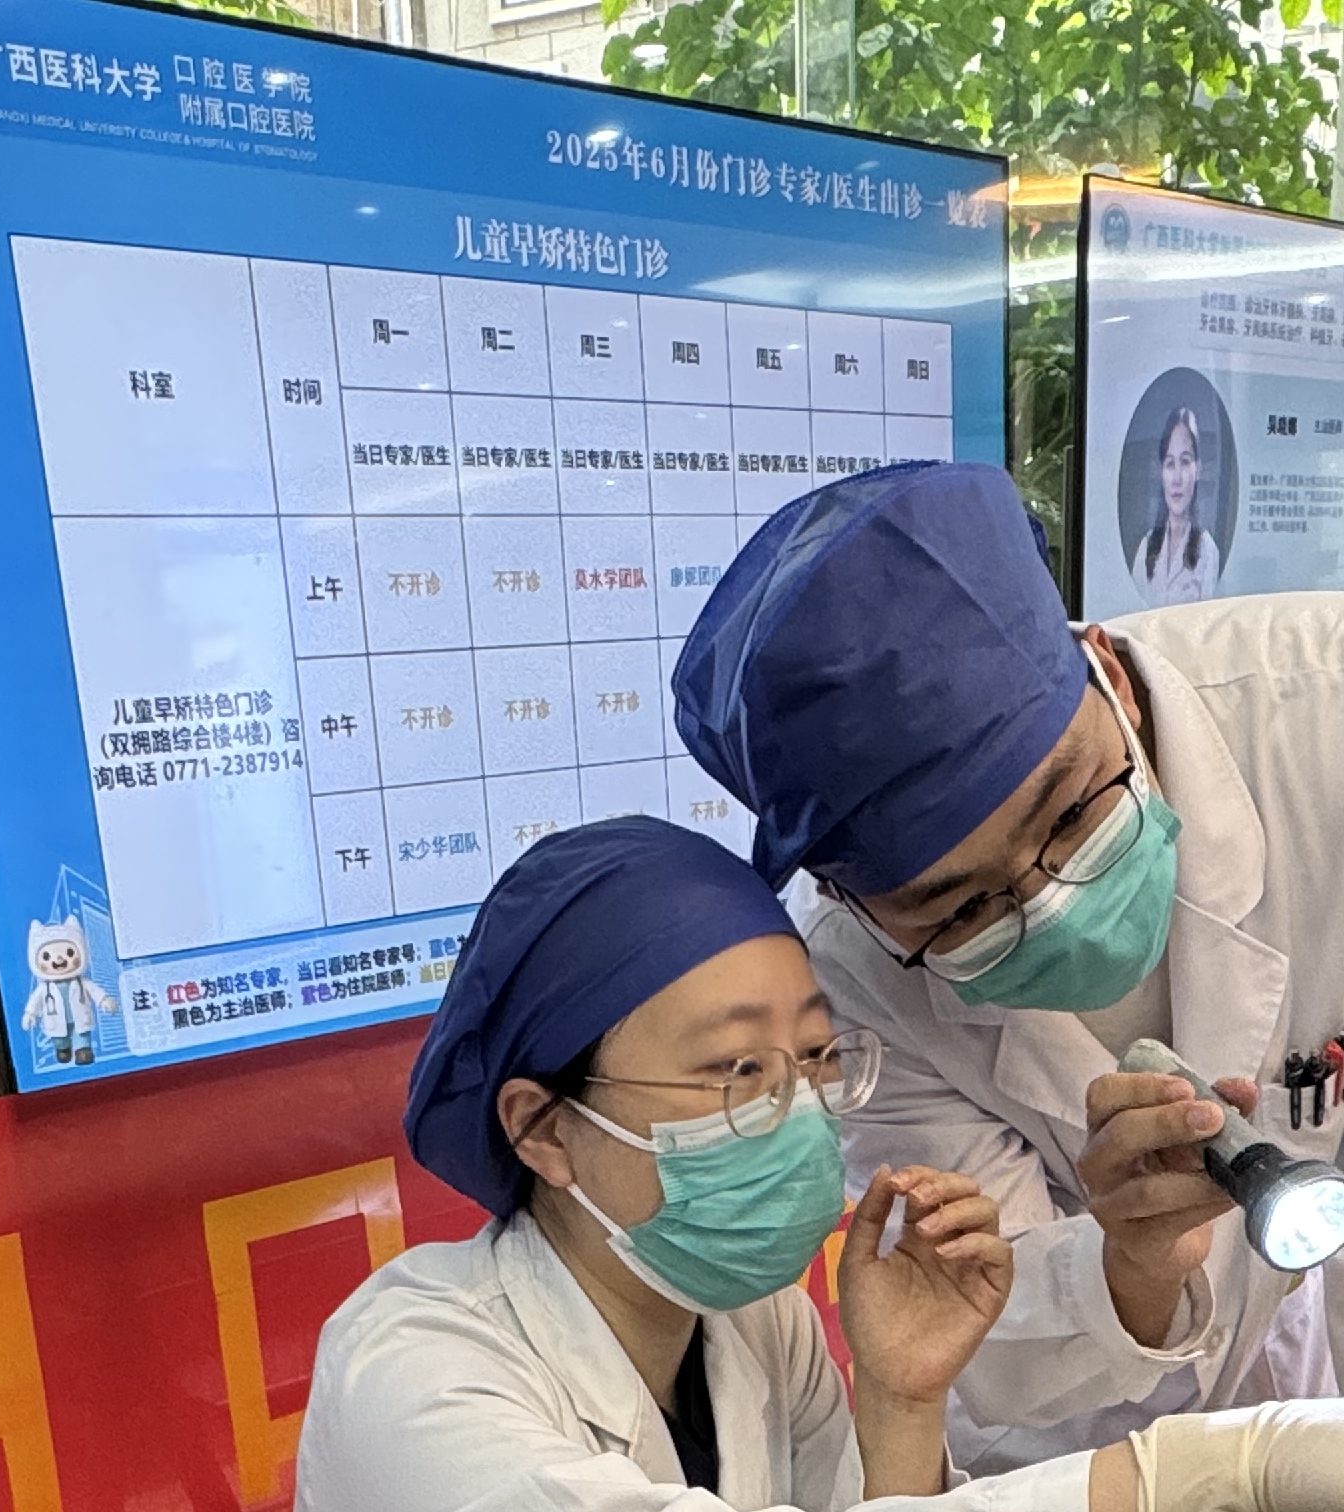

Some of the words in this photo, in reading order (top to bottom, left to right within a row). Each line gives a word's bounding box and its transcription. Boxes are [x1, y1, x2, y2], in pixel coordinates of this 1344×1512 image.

[173, 54, 314, 105] 口腔医学院
[31, 113, 76, 131] MEDICAL
[78, 119, 138, 139] UNIVERSITY
[180, 92, 317, 142] 附属口腔医院
[454, 216, 670, 280] 儿童早矫特色门诊
[372, 318, 411, 345] 周一
[481, 326, 516, 352] 周二
[580, 334, 613, 360] 周三
[672, 341, 701, 367] 周四
[756, 348, 783, 373] 周五
[834, 353, 859, 377] 周六
[907, 359, 930, 382] 周日
[129, 370, 175, 400] 科室
[282, 378, 322, 406] 时间
[353, 443, 452, 467] 当日专家/医生
[462, 446, 553, 469] 当日专家/医生
[560, 448, 645, 471] 当日专家/医生
[652, 451, 732, 473] 当日专家/医生
[738, 454, 810, 474] 当日专家/医生
[307, 575, 344, 602] 上午
[388, 571, 441, 597] 不开诊
[492, 570, 542, 594] 不开诊
[113, 690, 274, 727] 儿童早矫特色门诊
[504, 698, 551, 722] 不开诊
[596, 690, 641, 714] 不开诊
[320, 713, 359, 740] 中午
[401, 705, 454, 731] 不开诊
[93, 763, 158, 792] 询电话
[163, 749, 304, 783] 0771-2387914
[690, 798, 730, 823] 不开诊
[335, 848, 372, 874] 下午
